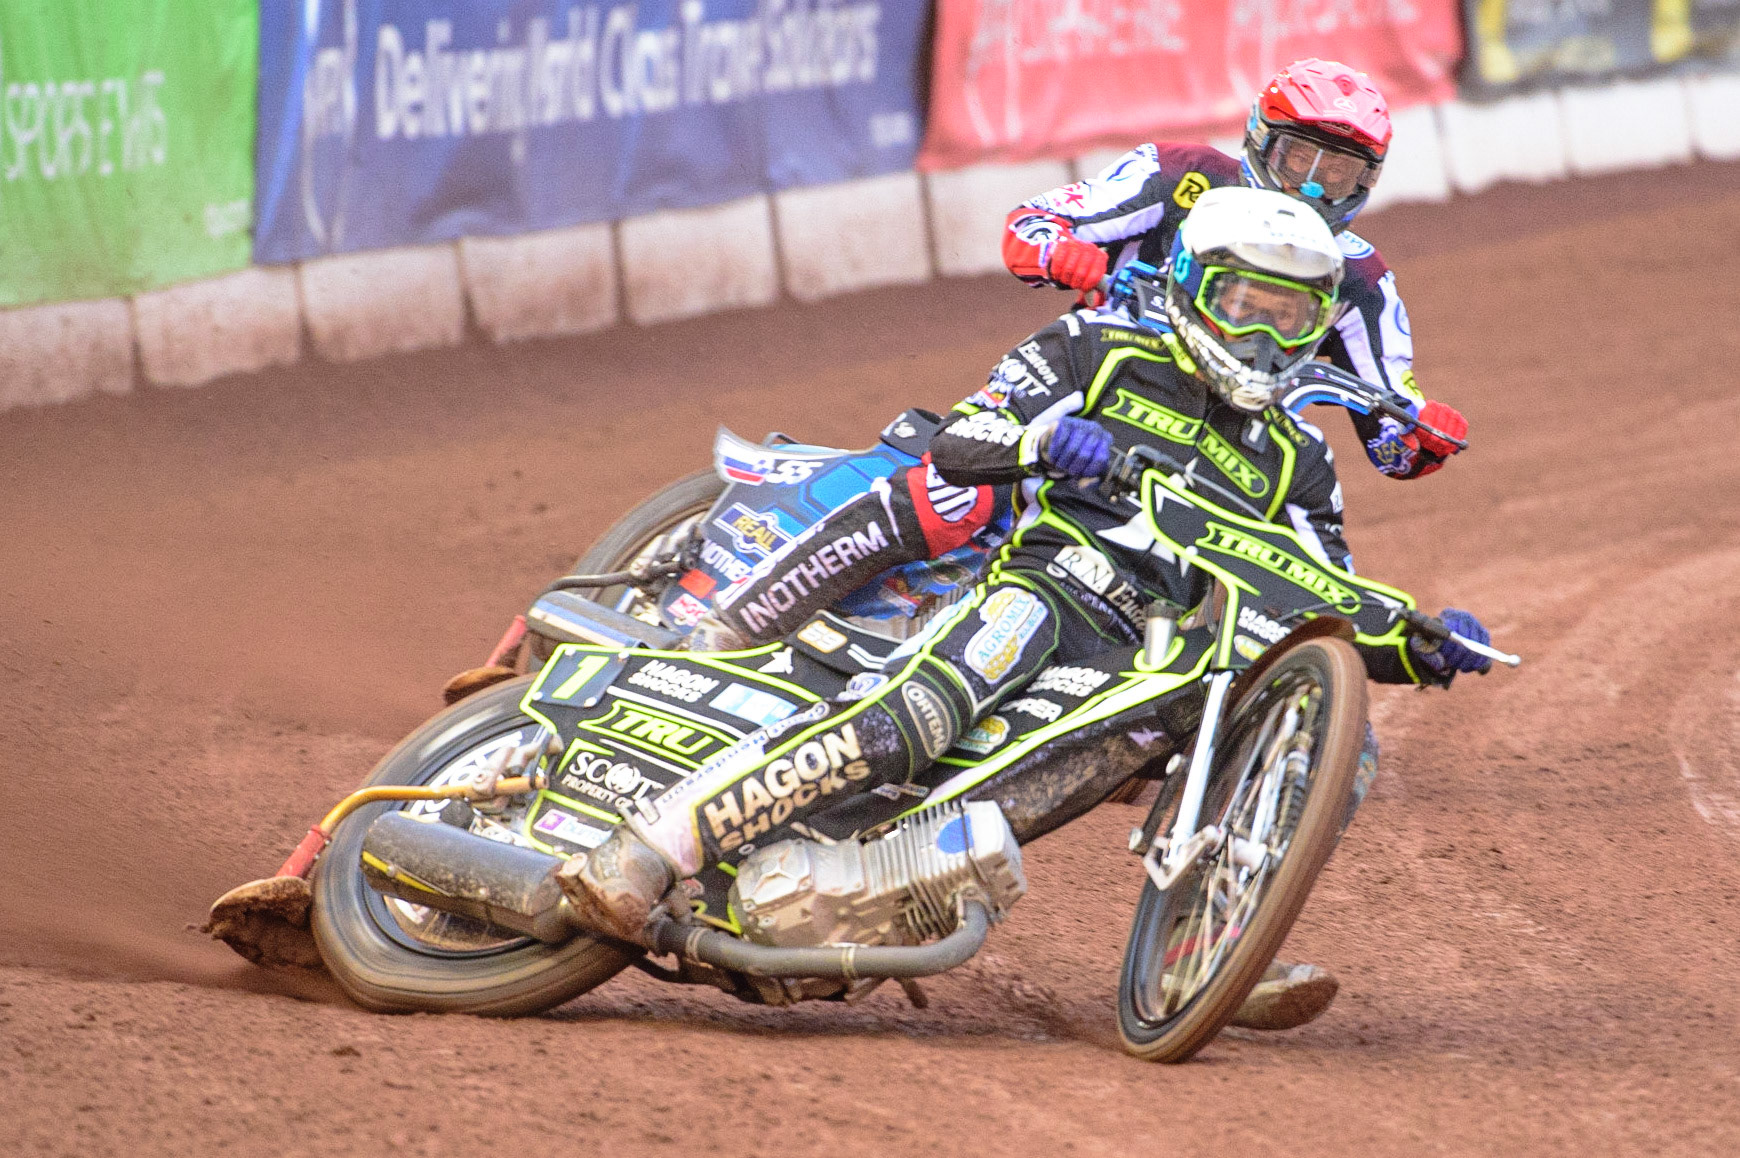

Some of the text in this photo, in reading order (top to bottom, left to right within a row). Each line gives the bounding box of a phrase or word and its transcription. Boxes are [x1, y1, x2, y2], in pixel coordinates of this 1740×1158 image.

[1126, 401, 1261, 491] TRU MIX
[700, 540, 754, 580] NOTHE
[739, 521, 890, 634] INOTHERM
[1217, 530, 1349, 604] TRU MIX
[978, 597, 1031, 663] AGROMIX
[1240, 606, 1292, 638] HAGO
[551, 655, 611, 699] 1
[628, 672, 703, 703] SHOCKS
[639, 659, 720, 695] HAGON
[611, 710, 714, 755] TRU
[704, 723, 862, 840] HAGON
[719, 759, 872, 850] SHOCKS
